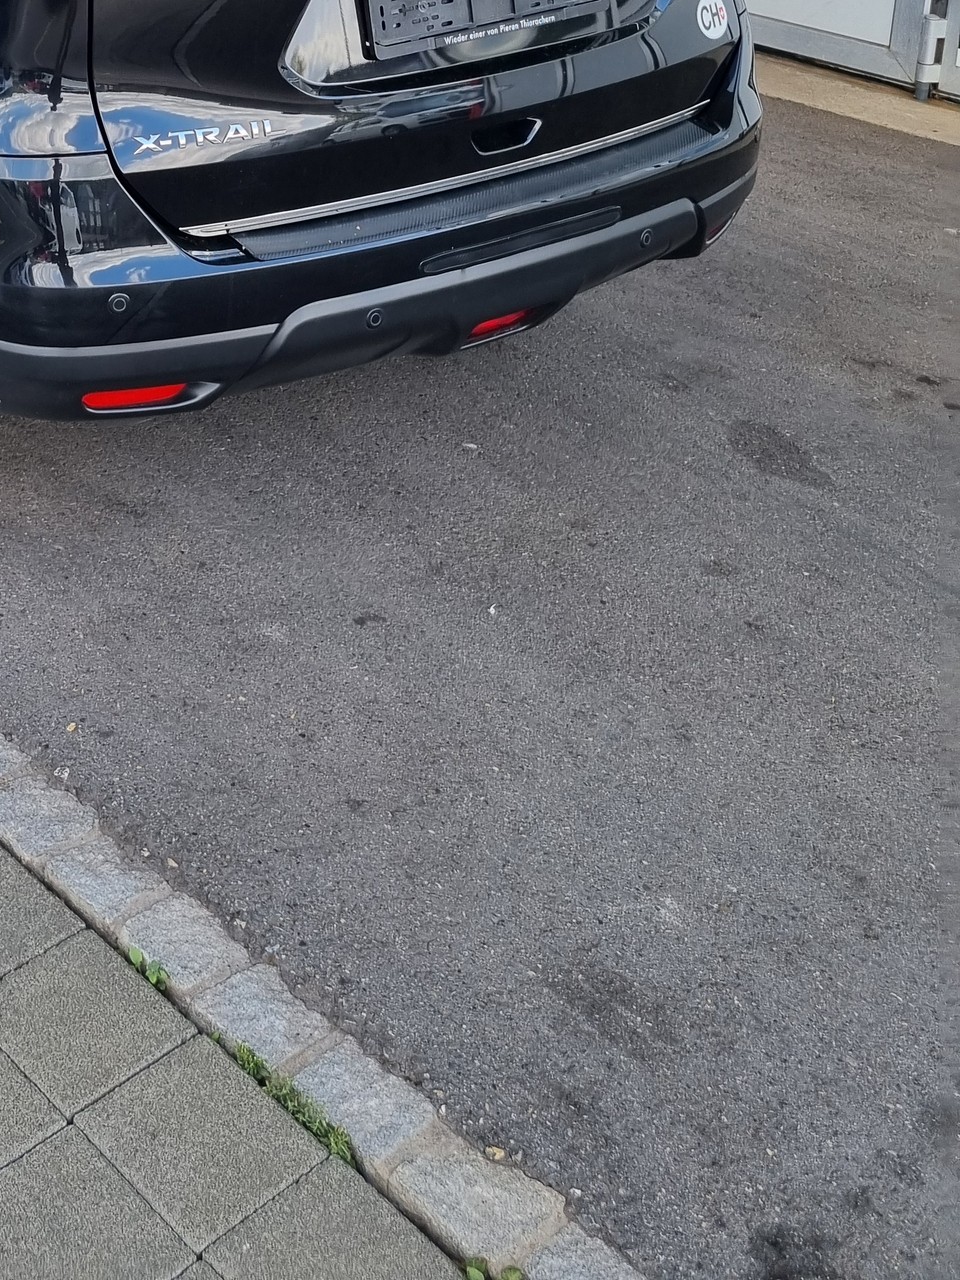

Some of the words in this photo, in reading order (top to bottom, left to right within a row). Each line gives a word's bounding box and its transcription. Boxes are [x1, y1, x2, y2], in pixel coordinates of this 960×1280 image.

[700, 2, 722, 31] CH
[443, 33, 468, 45] Wieder
[469, 30, 486, 40] einer
[486, 28, 499, 36] von
[500, 22, 519, 33] Pieren
[133, 119, 287, 155] X-TRAIL
